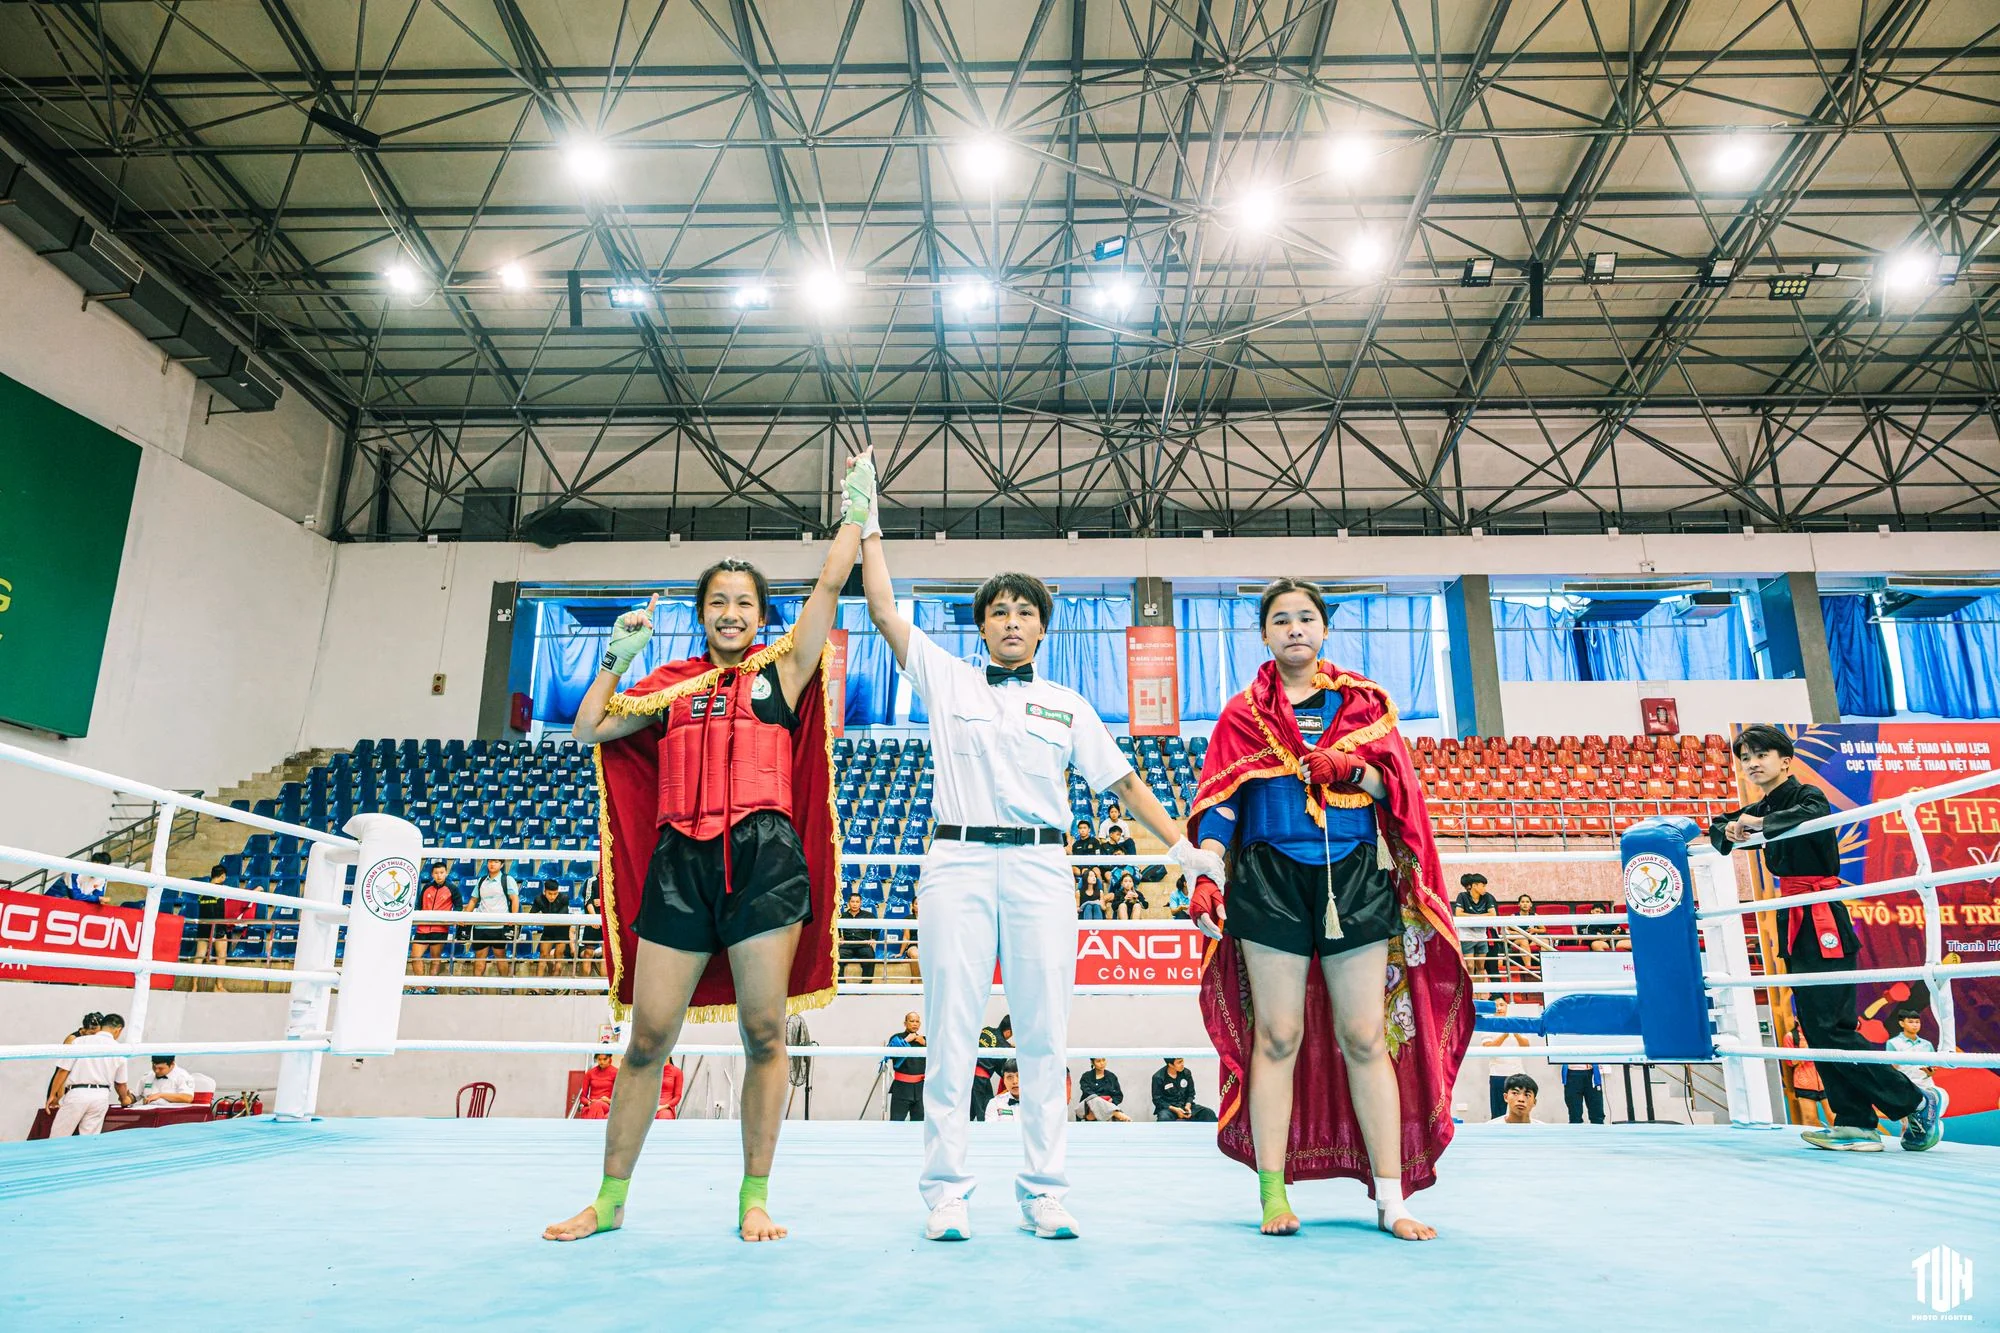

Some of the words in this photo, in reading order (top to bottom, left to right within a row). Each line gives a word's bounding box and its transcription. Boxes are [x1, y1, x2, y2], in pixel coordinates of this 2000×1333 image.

[694, 700, 724, 709] FIGER
[1840, 740, 1854, 756] BỘ
[1854, 741, 1874, 754] VĂN
[1897, 738, 1915, 754] THỂ
[1915, 742, 1940, 754] THAO
[1940, 740, 1954, 754] VÀ
[1954, 742, 1968, 754] DU
[1968, 742, 1990, 756] LỊCH
[1846, 759, 1865, 773] CỤC
[1866, 756, 1884, 771] THỂ
[1884, 759, 1904, 773] DỤC
[1904, 756, 1923, 771] THỂ
[1923, 759, 1947, 771] THAO
[1948, 757, 1968, 773] VIỆT
[1968, 759, 1992, 771] NAM
[1858, 901, 1891, 926] VÔ
[1897, 904, 1957, 930] ĐỊH
[44, 909, 143, 953] SƠN
[1077, 928, 1181, 960] ĂNG
[1946, 940, 1985, 952] Thanh
[1098, 965, 1156, 980] CÔNG
